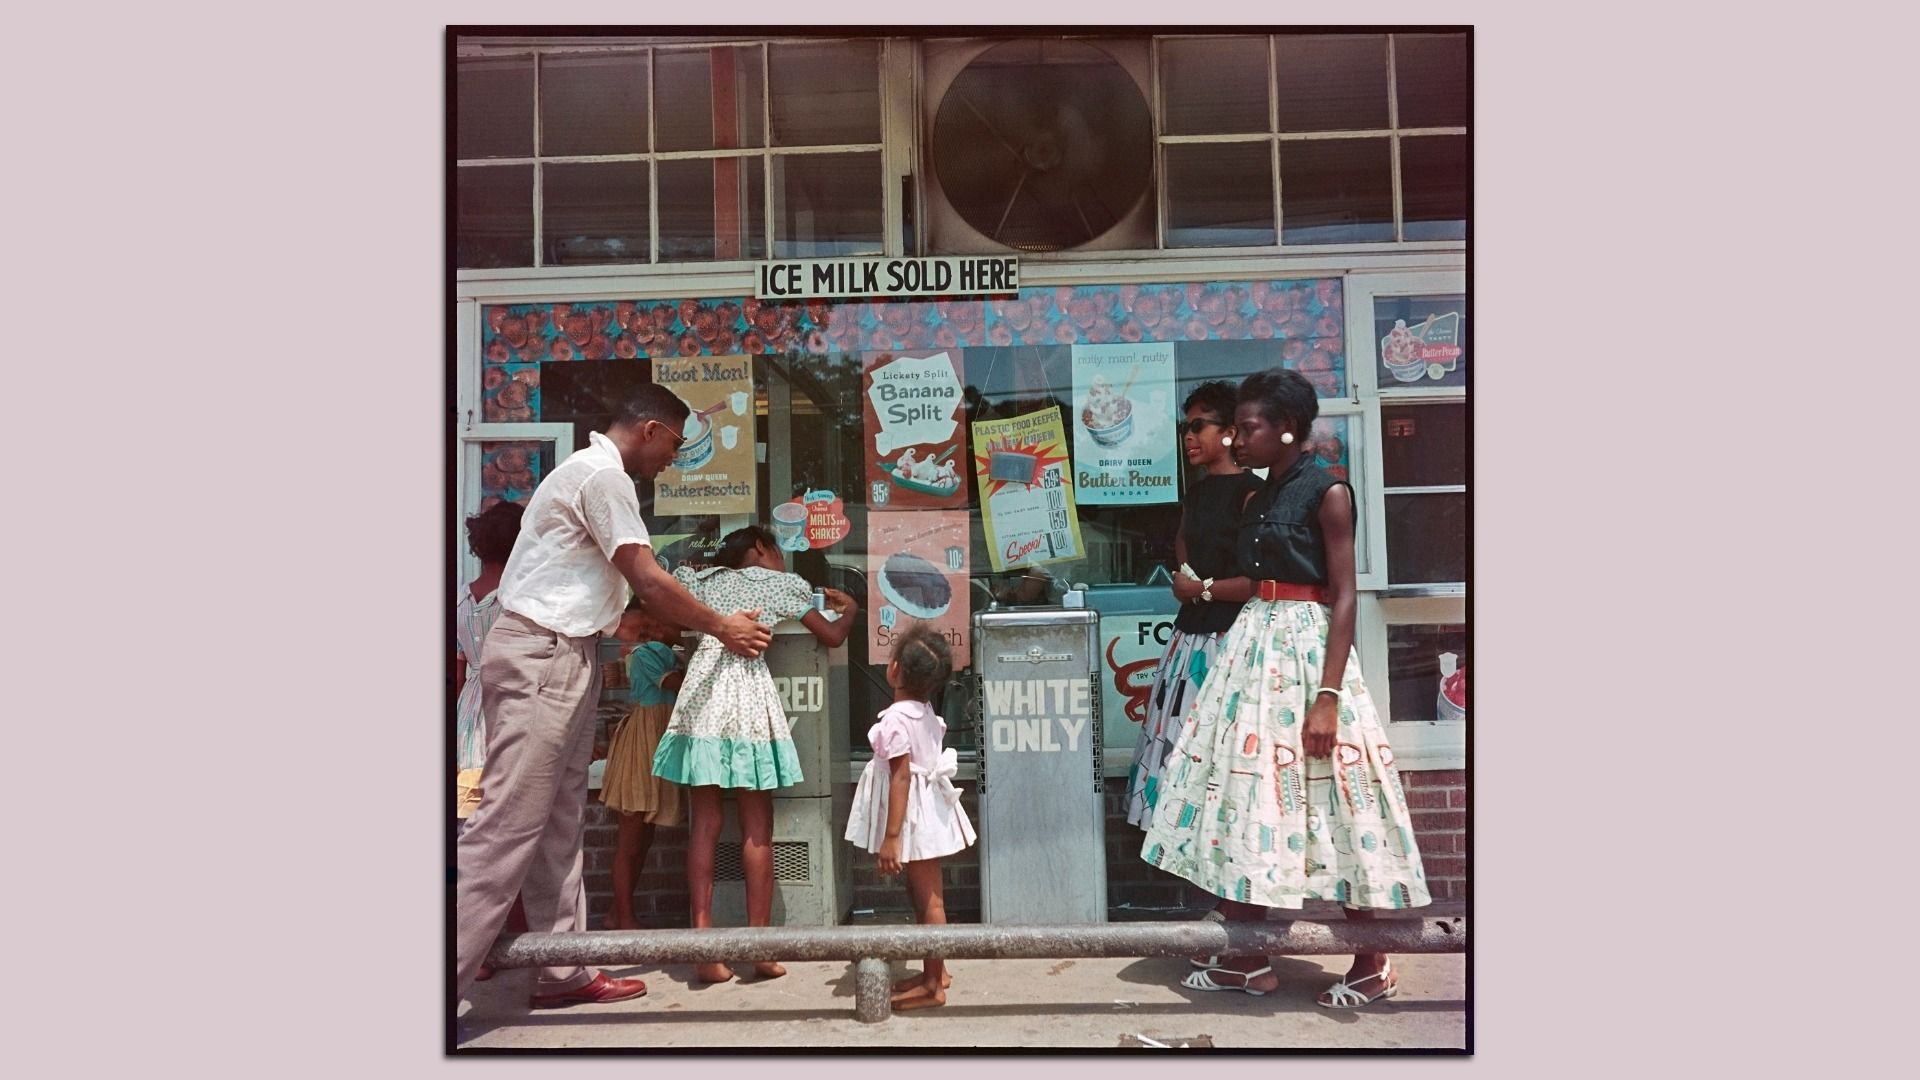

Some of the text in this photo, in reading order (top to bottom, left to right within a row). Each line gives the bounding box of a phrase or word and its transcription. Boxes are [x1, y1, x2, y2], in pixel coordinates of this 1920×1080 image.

[761, 258, 1018, 295] ICE MILK SOLD HERE
[1142, 351, 1169, 364] nutty
[655, 361, 749, 383] Hoot Mon!
[882, 370, 948, 380] Lickety Split
[877, 384, 955, 402] Banana
[887, 403, 943, 426] Split
[974, 423, 1011, 437] PLASTIC
[1012, 418, 1031, 432] FOOD
[1099, 458, 1152, 467] DAIRY QUEEN
[1078, 470, 1174, 488] Butter Pecan
[658, 481, 751, 498] Butterscotch
[810, 514, 836, 526] MALTS
[810, 528, 841, 540] SHAKES
[1136, 672, 1149, 680] TRY
[774, 676, 824, 712] RED
[984, 678, 1090, 716] WHITE
[992, 718, 1087, 753] ONLY
